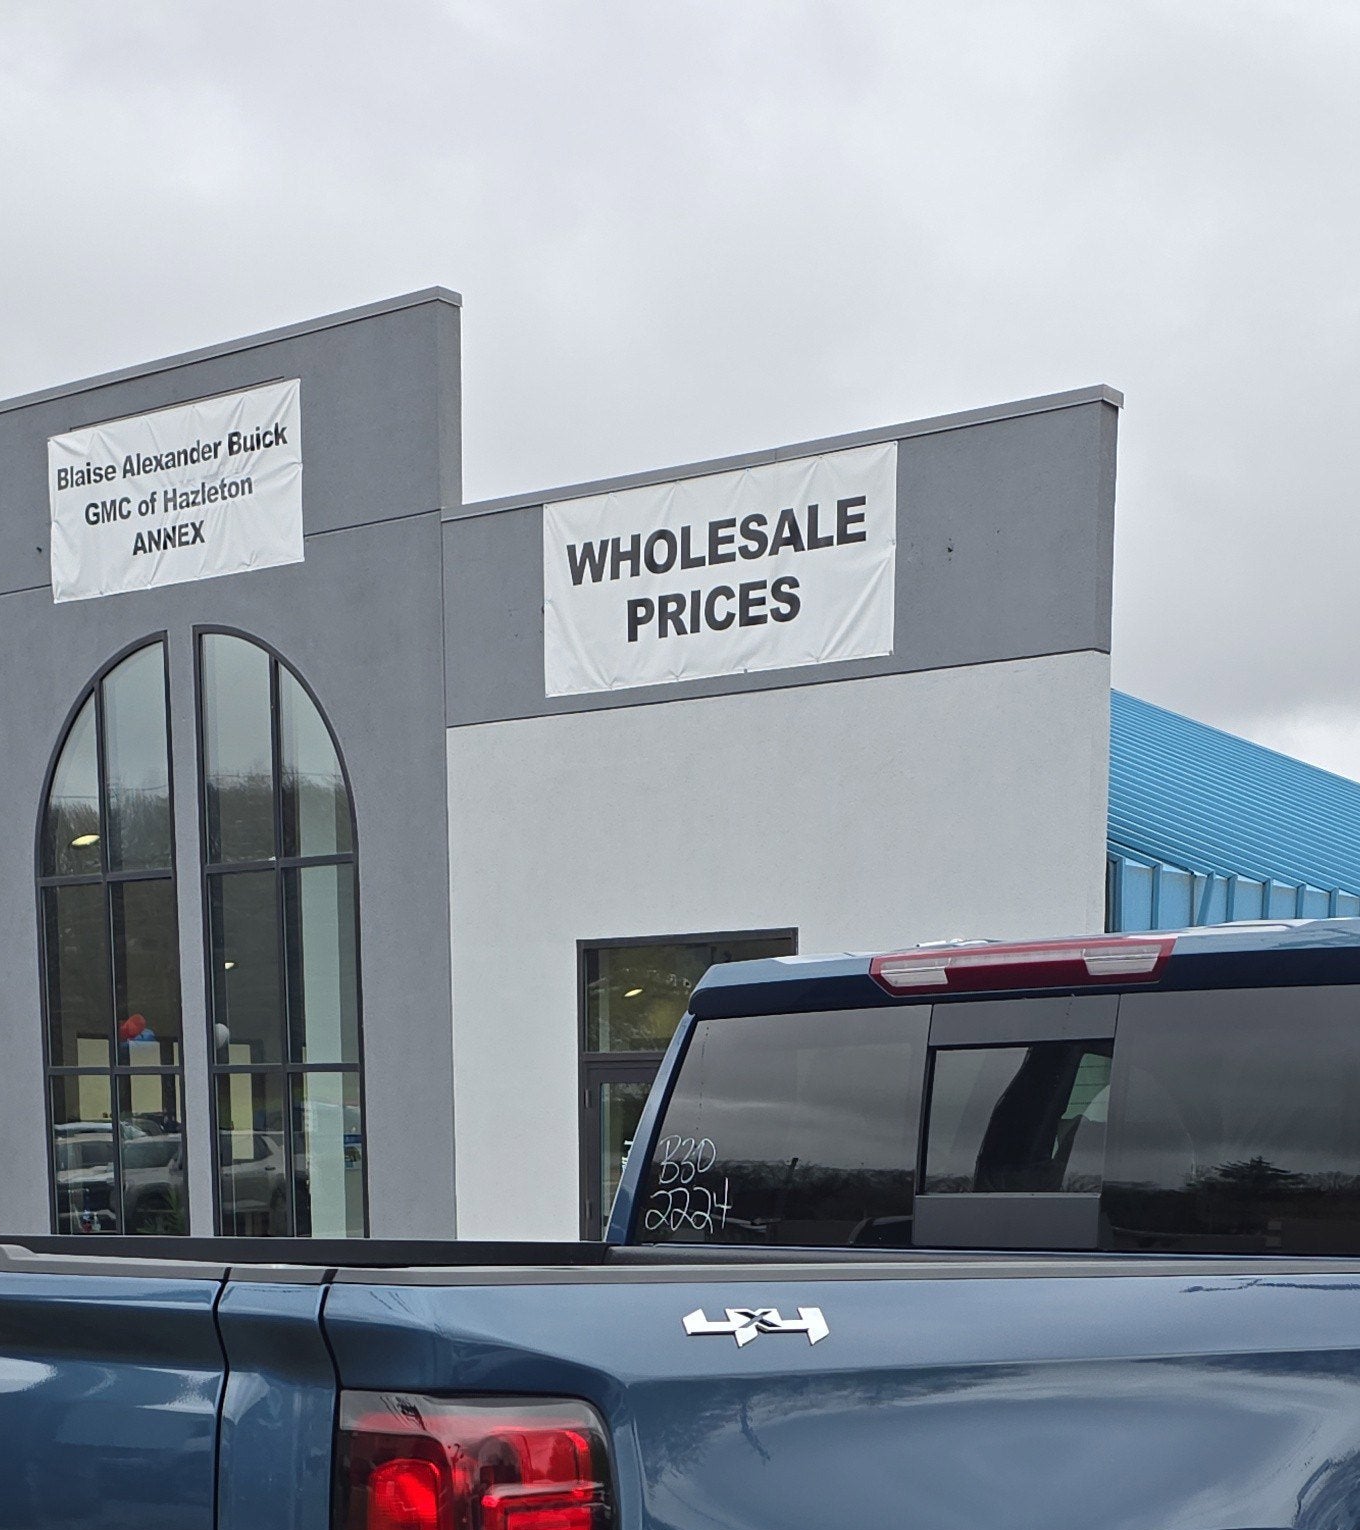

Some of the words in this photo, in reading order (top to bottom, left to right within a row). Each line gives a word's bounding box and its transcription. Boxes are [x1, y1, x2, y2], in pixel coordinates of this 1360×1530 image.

[57, 462, 116, 490] Blaise
[122, 439, 221, 479] Alexander
[228, 422, 288, 456] Buick
[85, 496, 131, 525] GMC
[138, 491, 156, 517] of
[163, 477, 253, 513] Hazleton
[132, 520, 205, 556] ANNEX
[566, 495, 867, 586] WHOLESALE
[626, 576, 801, 643] PRICES
[645, 1177, 732, 1234] 2224
